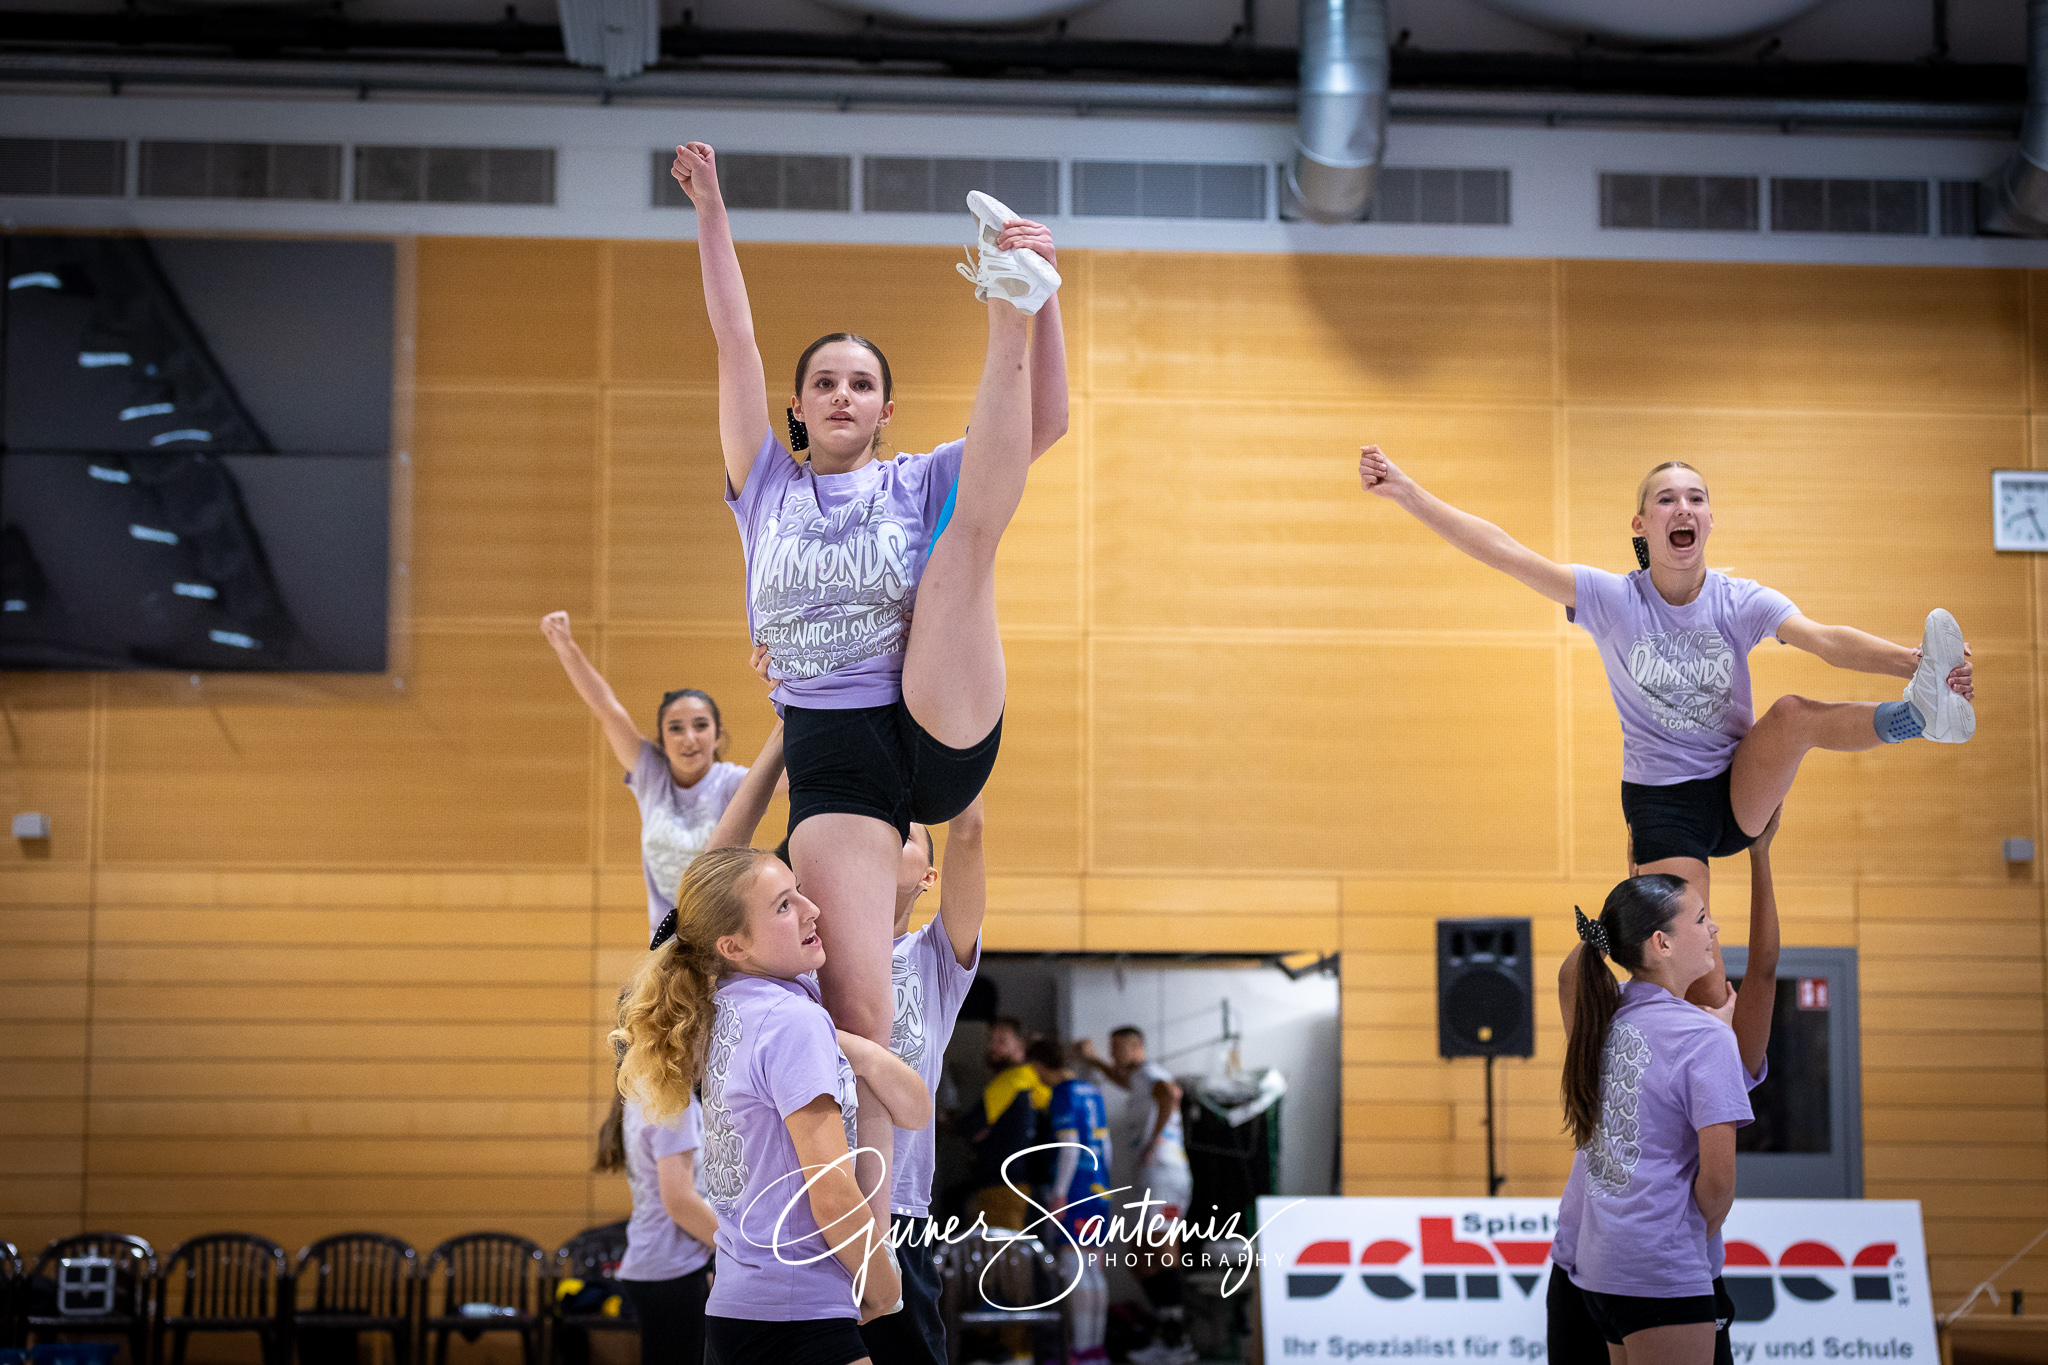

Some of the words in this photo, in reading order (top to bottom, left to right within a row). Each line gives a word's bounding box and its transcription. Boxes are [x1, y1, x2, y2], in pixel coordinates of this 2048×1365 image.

[790, 617, 847, 649] WATCH
[851, 608, 883, 641] OUT
[1629, 642, 1734, 690] DIAMONDS
[1283, 1336, 1317, 1357] Ihr
[1327, 1335, 1455, 1362] Spezialist
[1464, 1336, 1500, 1358] für
[1764, 1338, 1814, 1359] und
[1823, 1336, 1914, 1359] Schule
